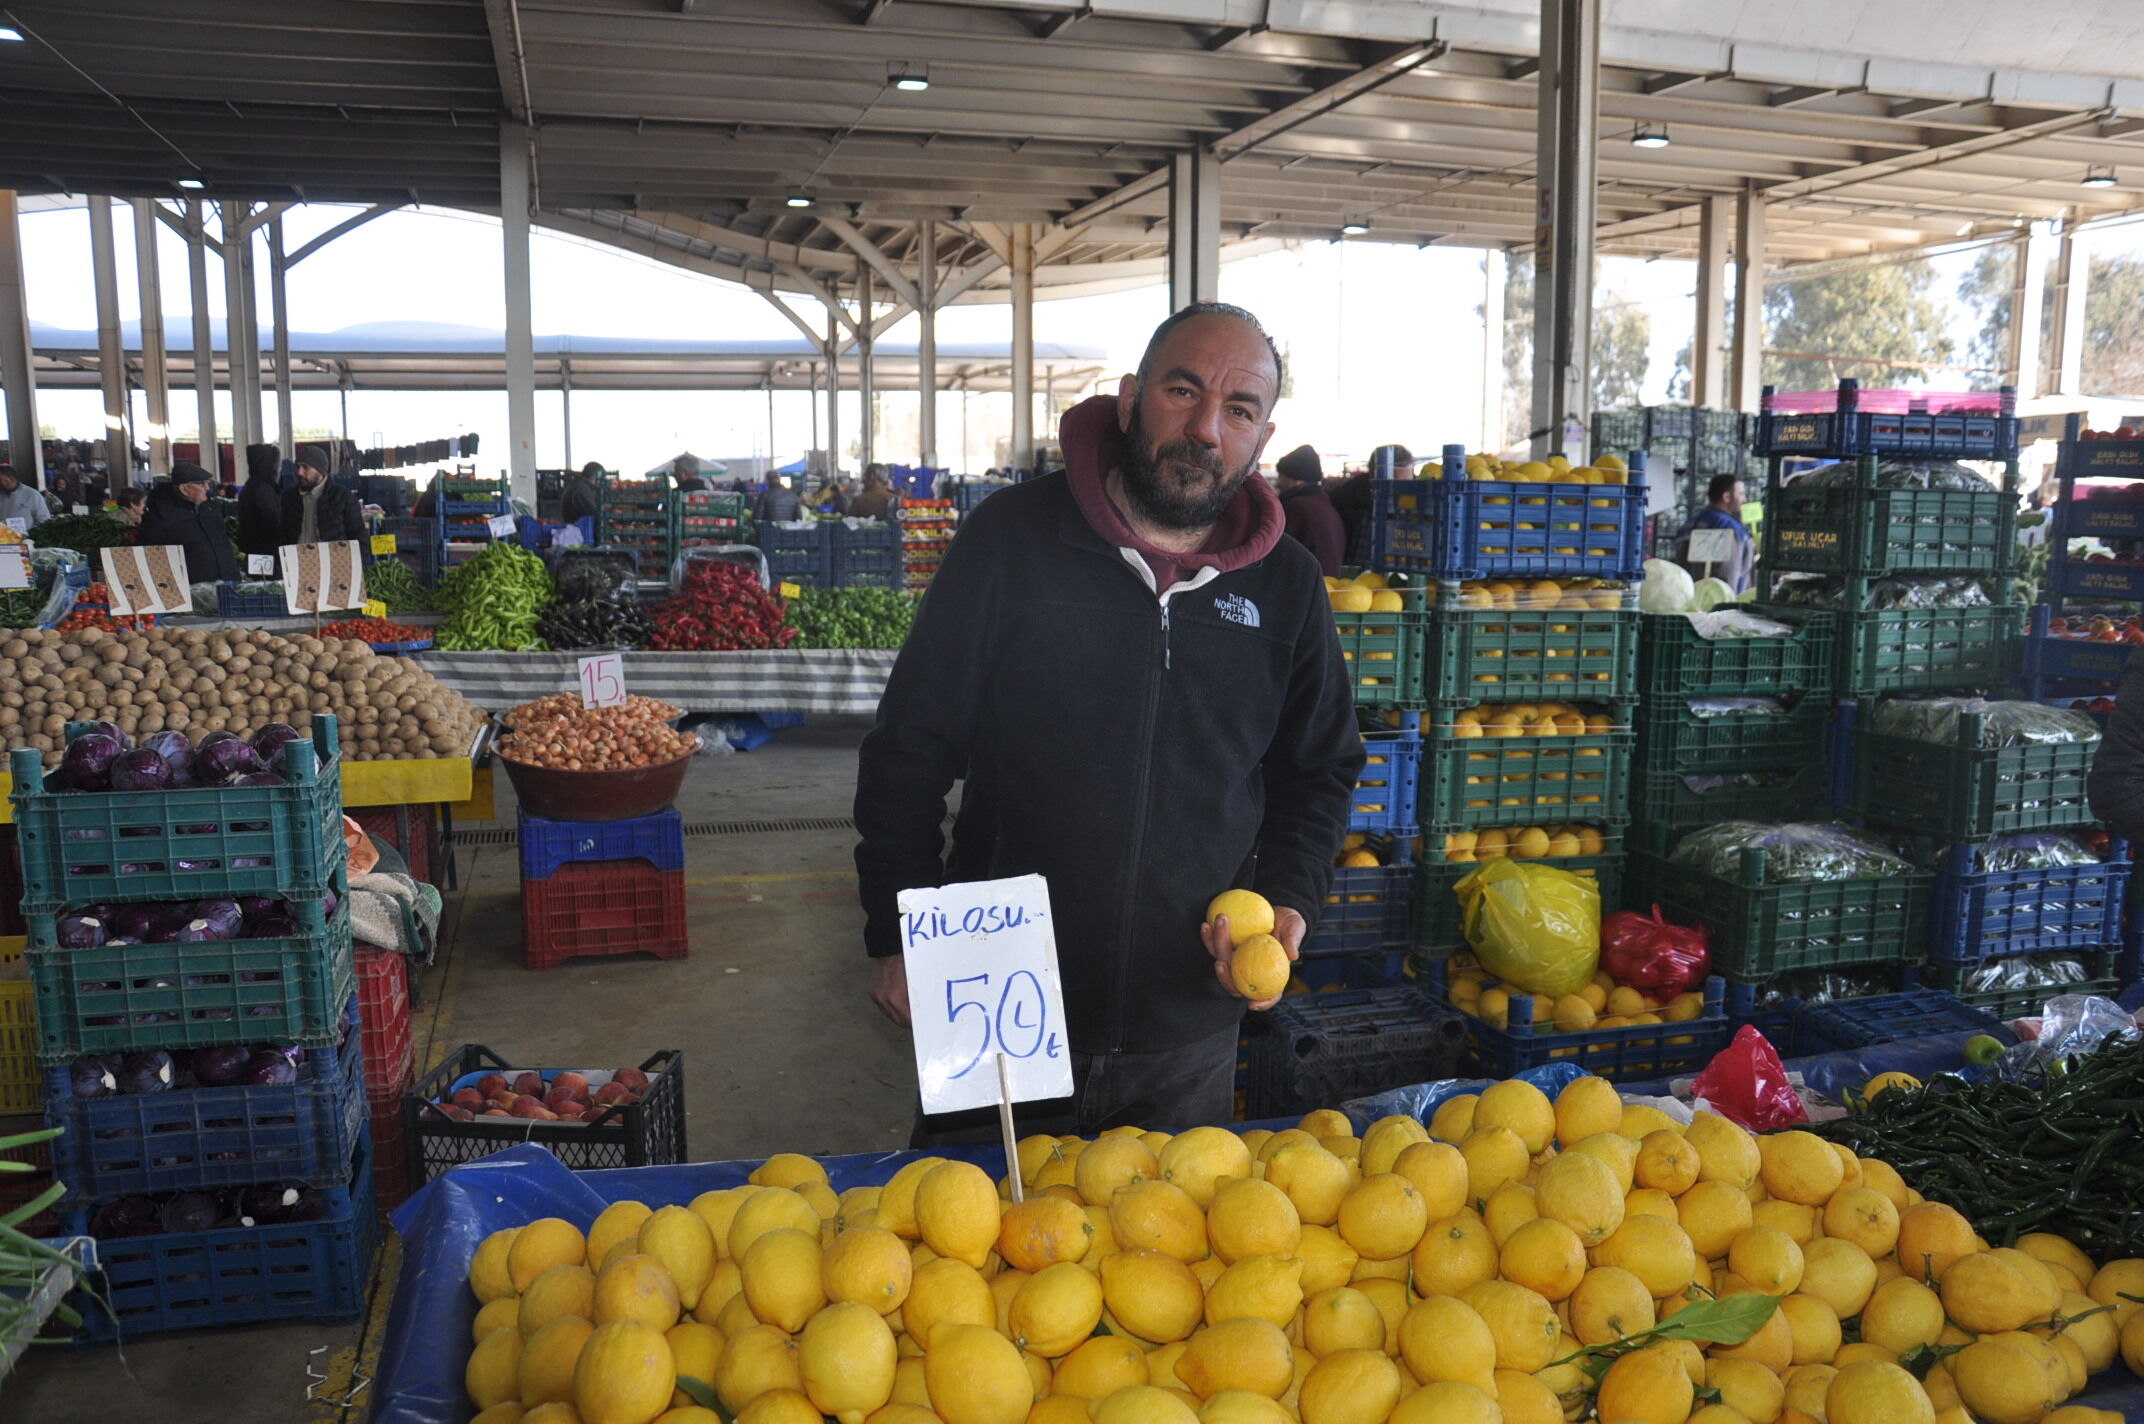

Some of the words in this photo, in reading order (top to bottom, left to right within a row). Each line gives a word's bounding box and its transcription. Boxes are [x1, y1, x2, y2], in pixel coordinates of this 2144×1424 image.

[1214, 597, 1245, 615] NORTH
[1229, 592, 1245, 606] THE
[1221, 610, 1244, 624] FACE
[582, 658, 619, 704] 15
